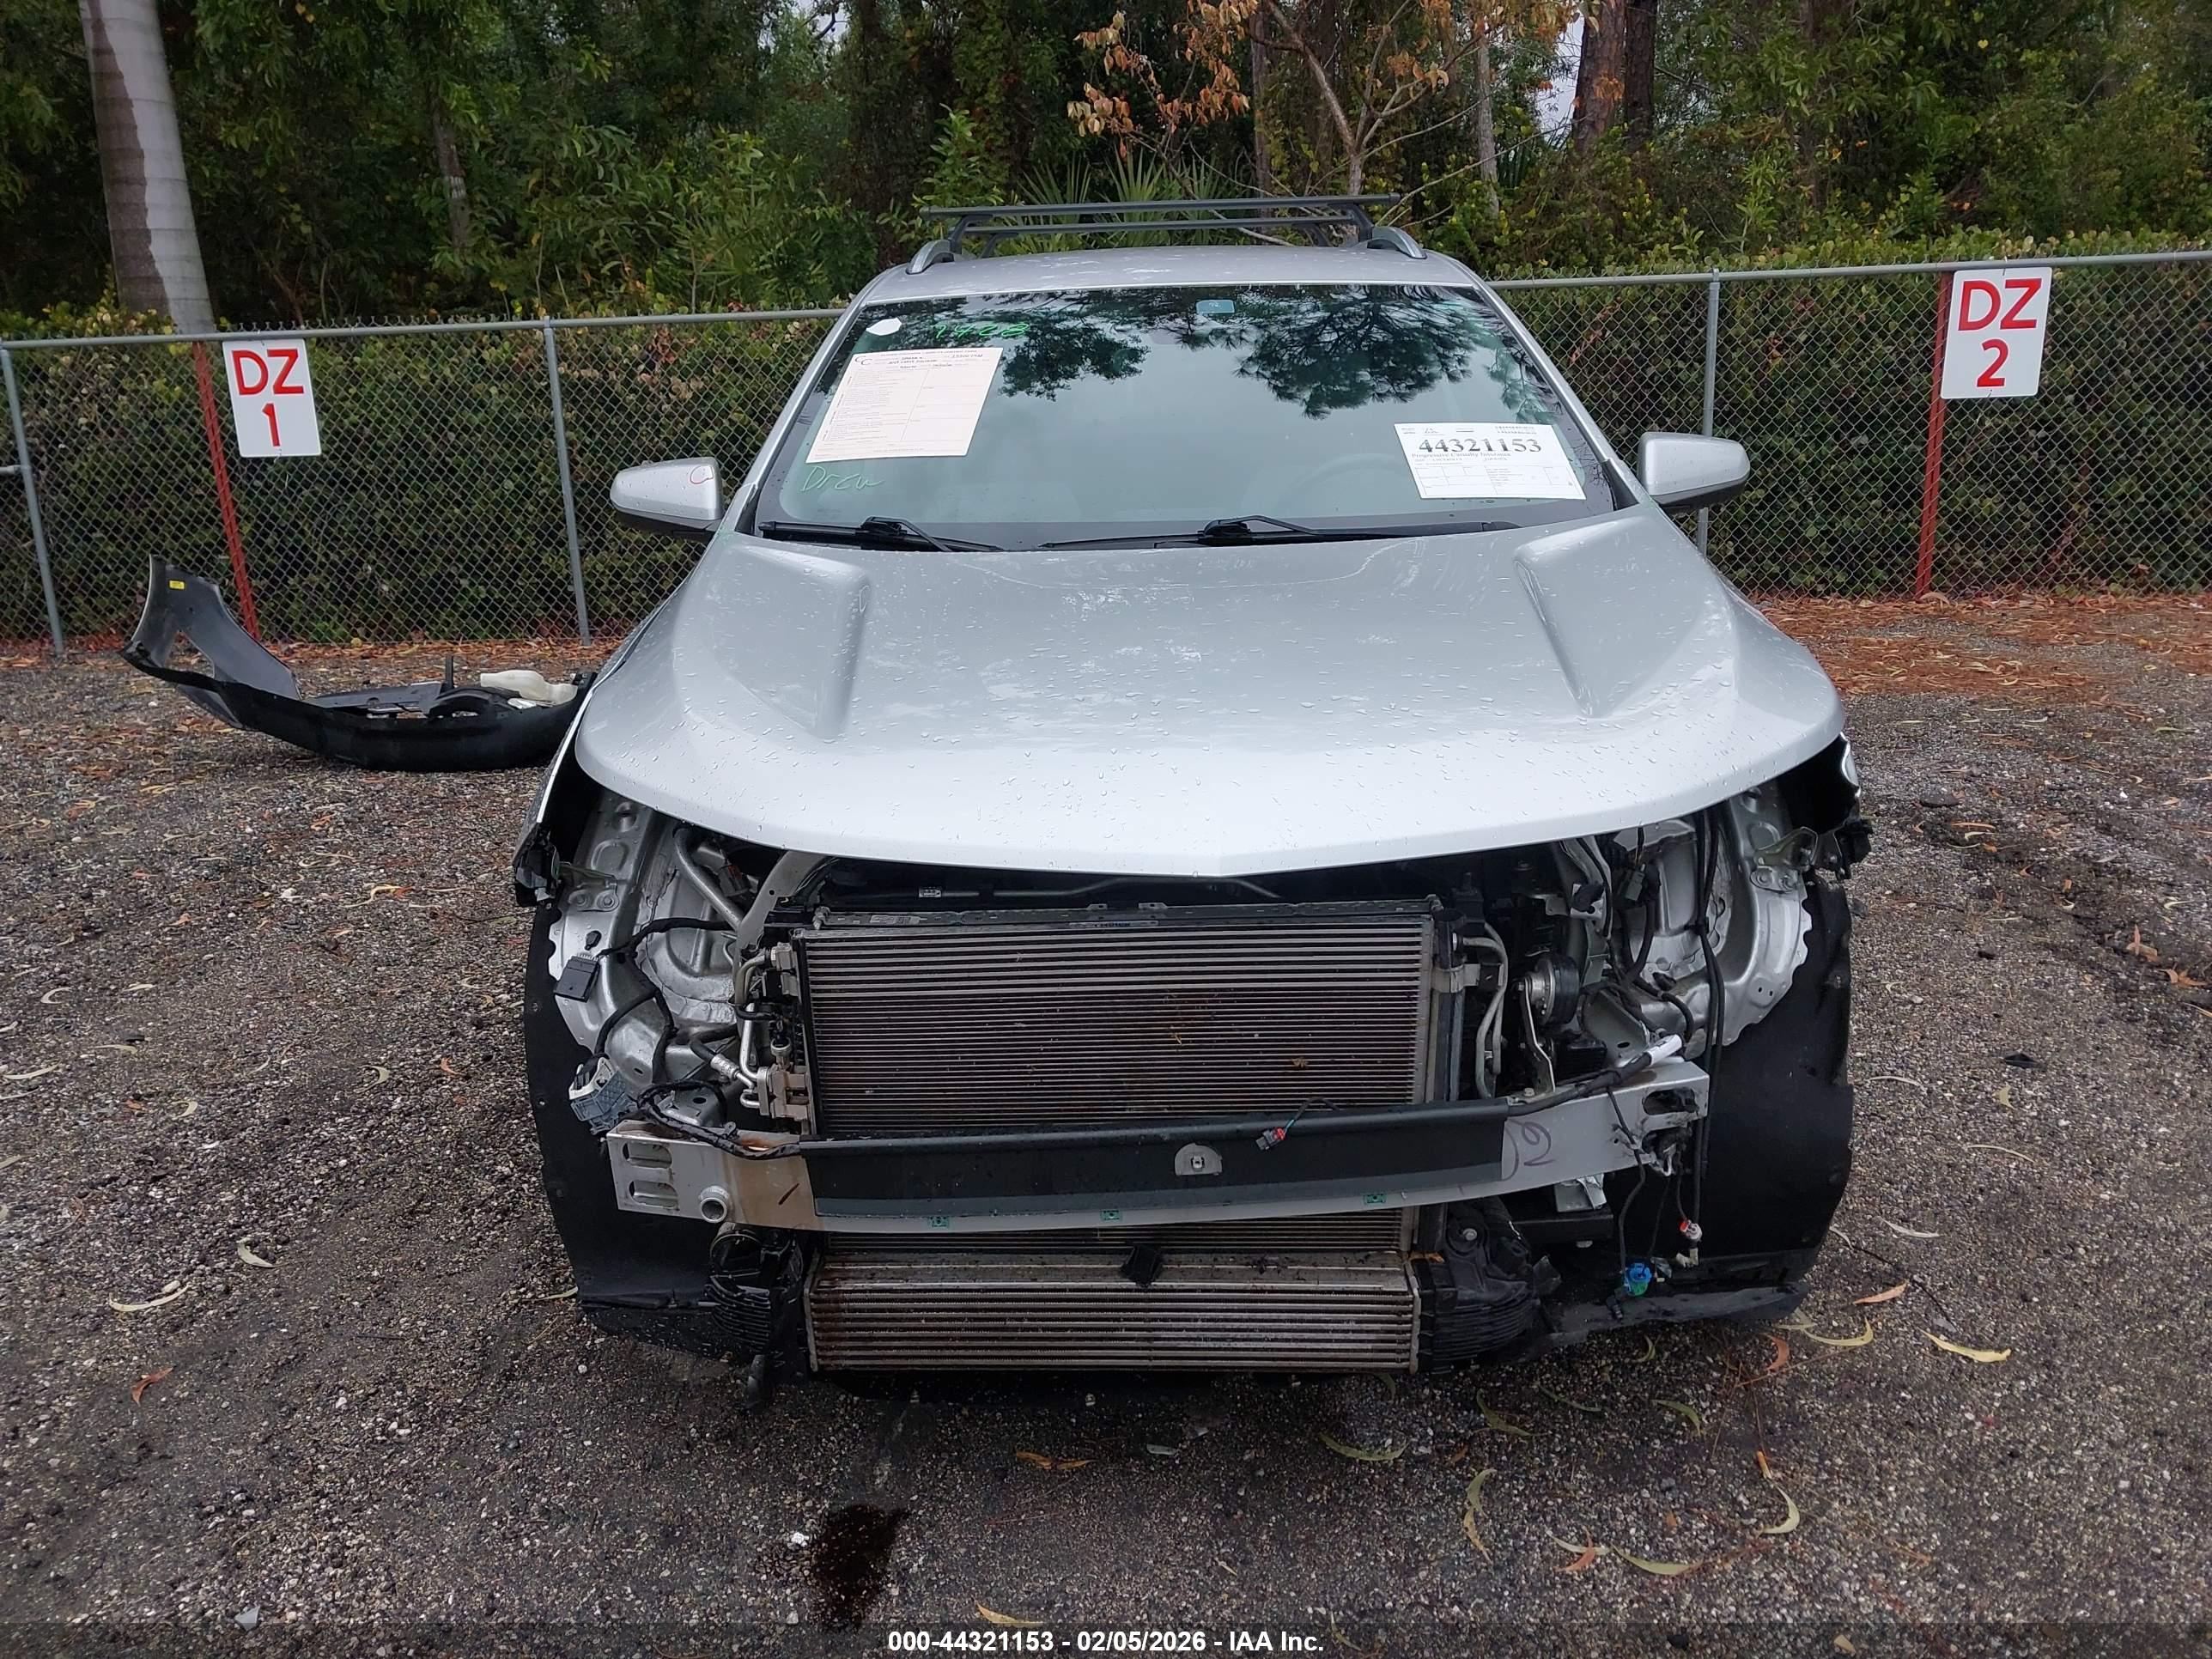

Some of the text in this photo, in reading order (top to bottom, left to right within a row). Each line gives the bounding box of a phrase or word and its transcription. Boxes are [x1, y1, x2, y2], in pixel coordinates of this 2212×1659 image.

[1958, 278, 2042, 331] DZ
[232, 349, 304, 395] DZ
[1977, 338, 2008, 387] 2
[262, 403, 280, 447] 1
[1419, 438, 1542, 453] 44321153
